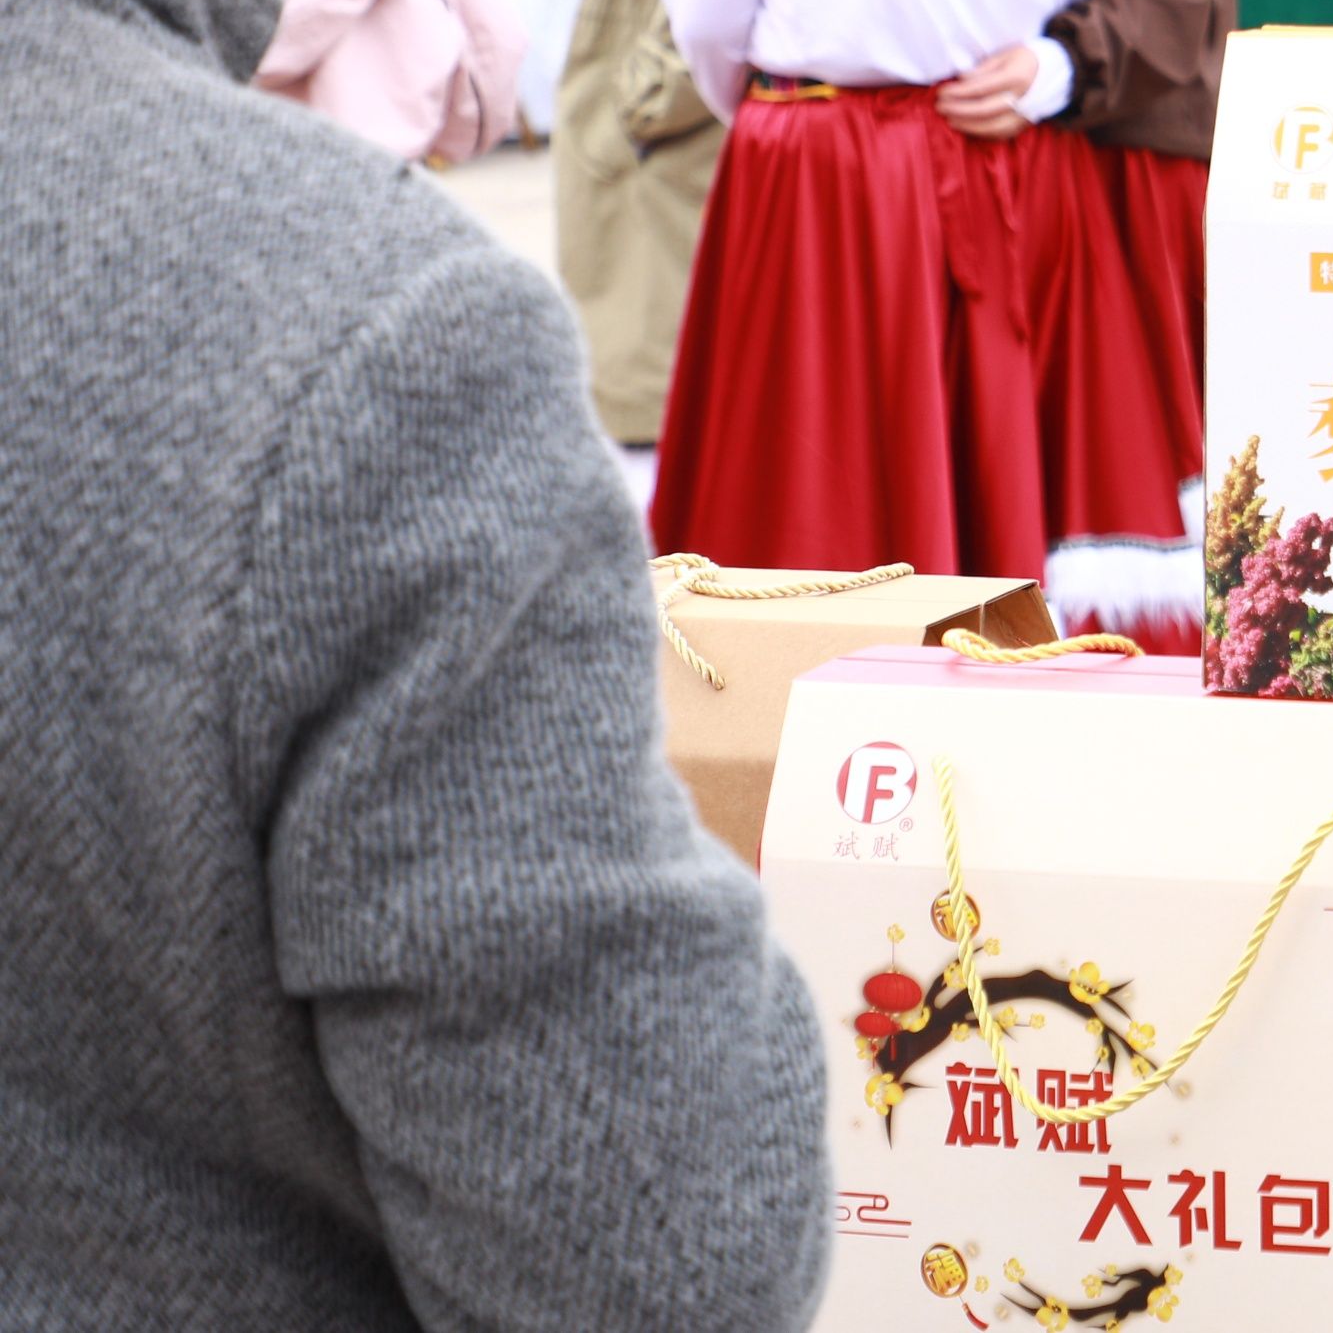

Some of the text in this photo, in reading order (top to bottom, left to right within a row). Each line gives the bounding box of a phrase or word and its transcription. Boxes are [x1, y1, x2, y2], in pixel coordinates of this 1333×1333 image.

[832, 830, 899, 861] 斌赋
[945, 1061, 1114, 1155] 斌赋
[1078, 1163, 1332, 1256] 大礼包
